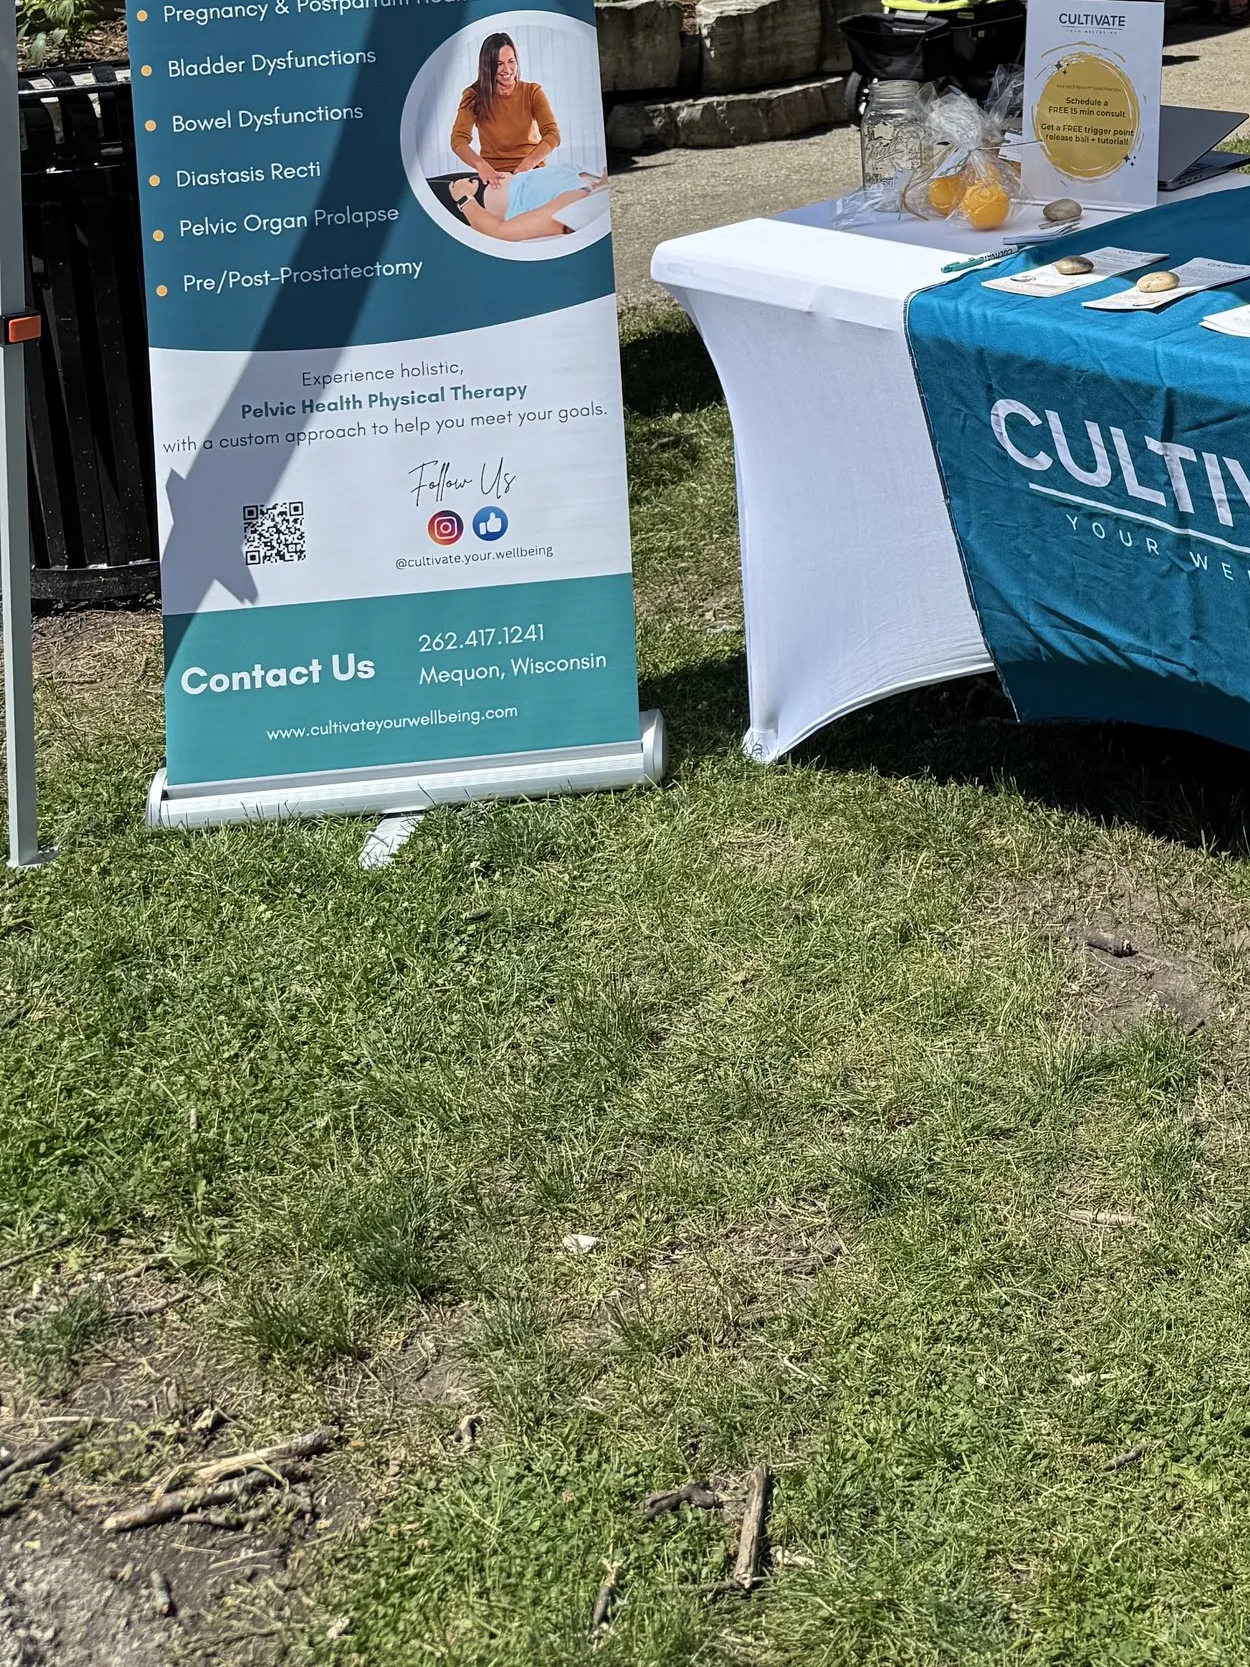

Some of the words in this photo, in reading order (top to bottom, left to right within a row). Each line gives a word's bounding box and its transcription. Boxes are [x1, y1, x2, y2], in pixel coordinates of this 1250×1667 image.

[163, 0, 269, 25] Pregnancy
[1059, 13, 1125, 27] CULTIVATE
[168, 59, 245, 79] Bladder
[251, 47, 377, 76] Dysfunctions
[1049, 106, 1068, 114] FREE
[1080, 108, 1094, 116] min
[1096, 109, 1125, 118] consult
[1066, 97, 1101, 107] Schedule
[172, 110, 231, 133] Bowel
[238, 104, 364, 130] Dysfunctions
[1041, 123, 1054, 131] Get
[1063, 125, 1082, 133] FREE
[1084, 127, 1111, 136] trigger
[1046, 133, 1073, 142] release
[176, 165, 265, 188] Diastasis
[271, 162, 321, 180] Recti
[180, 218, 238, 238] Pelvic
[243, 213, 308, 236] Organ
[314, 206, 400, 229] Prolapse
[183, 260, 423, 294] Pre/Post-Prostatectomy
[301, 366, 395, 389] Experience
[401, 362, 464, 381] holistic,
[241, 401, 296, 419] Pelvic
[301, 395, 363, 414] Health
[368, 387, 446, 410] Physical
[450, 383, 528, 404] Therapy
[163, 436, 197, 453] with
[203, 439, 213, 449] a
[219, 431, 279, 449] custom
[285, 423, 367, 444] approach
[372, 422, 388, 434] to
[394, 416, 430, 437] help
[436, 417, 465, 435] you
[470, 412, 512, 427] meet
[518, 412, 553, 428] your
[559, 405, 608, 426] goals.
[408, 460, 473, 506] Follow
[480, 456, 516, 500] Us
[1065, 513, 1159, 556] YOUR
[395, 544, 554, 570] @cultivate.your.wellbeing
[418, 624, 545, 653] 262.417.1241
[180, 659, 322, 696] Contact
[332, 653, 375, 681] Us
[419, 665, 505, 687] Mequon,
[511, 654, 607, 677] Wisconsin
[267, 705, 518, 741] www.cultivateyourwellbeing.com
